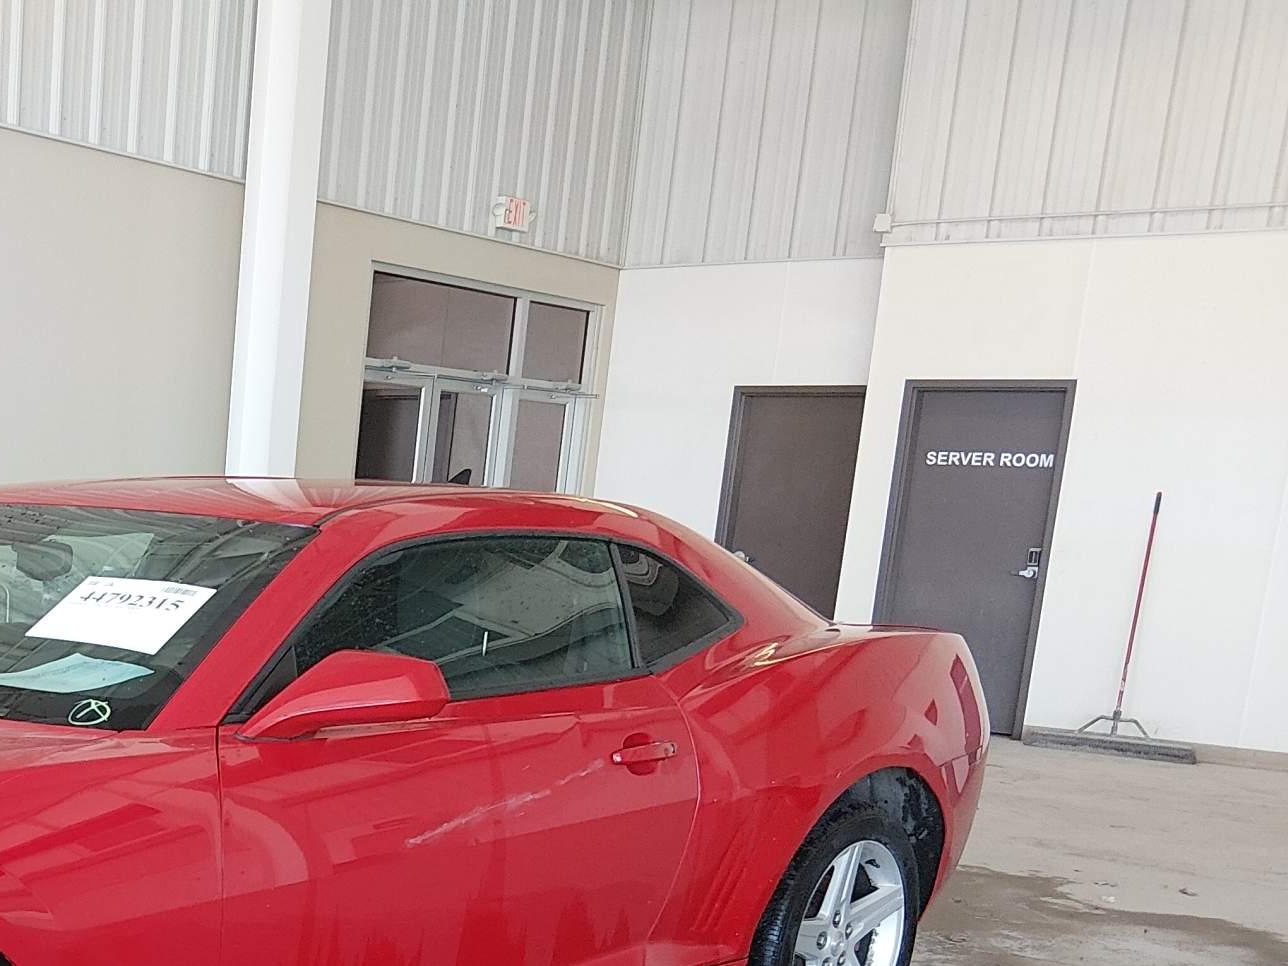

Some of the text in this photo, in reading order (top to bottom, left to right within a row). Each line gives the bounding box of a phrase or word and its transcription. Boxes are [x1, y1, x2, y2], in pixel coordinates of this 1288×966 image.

[507, 198, 526, 225] EXIT
[925, 451, 1055, 468] SERVER ROOM
[79, 591, 185, 611] 44792315
